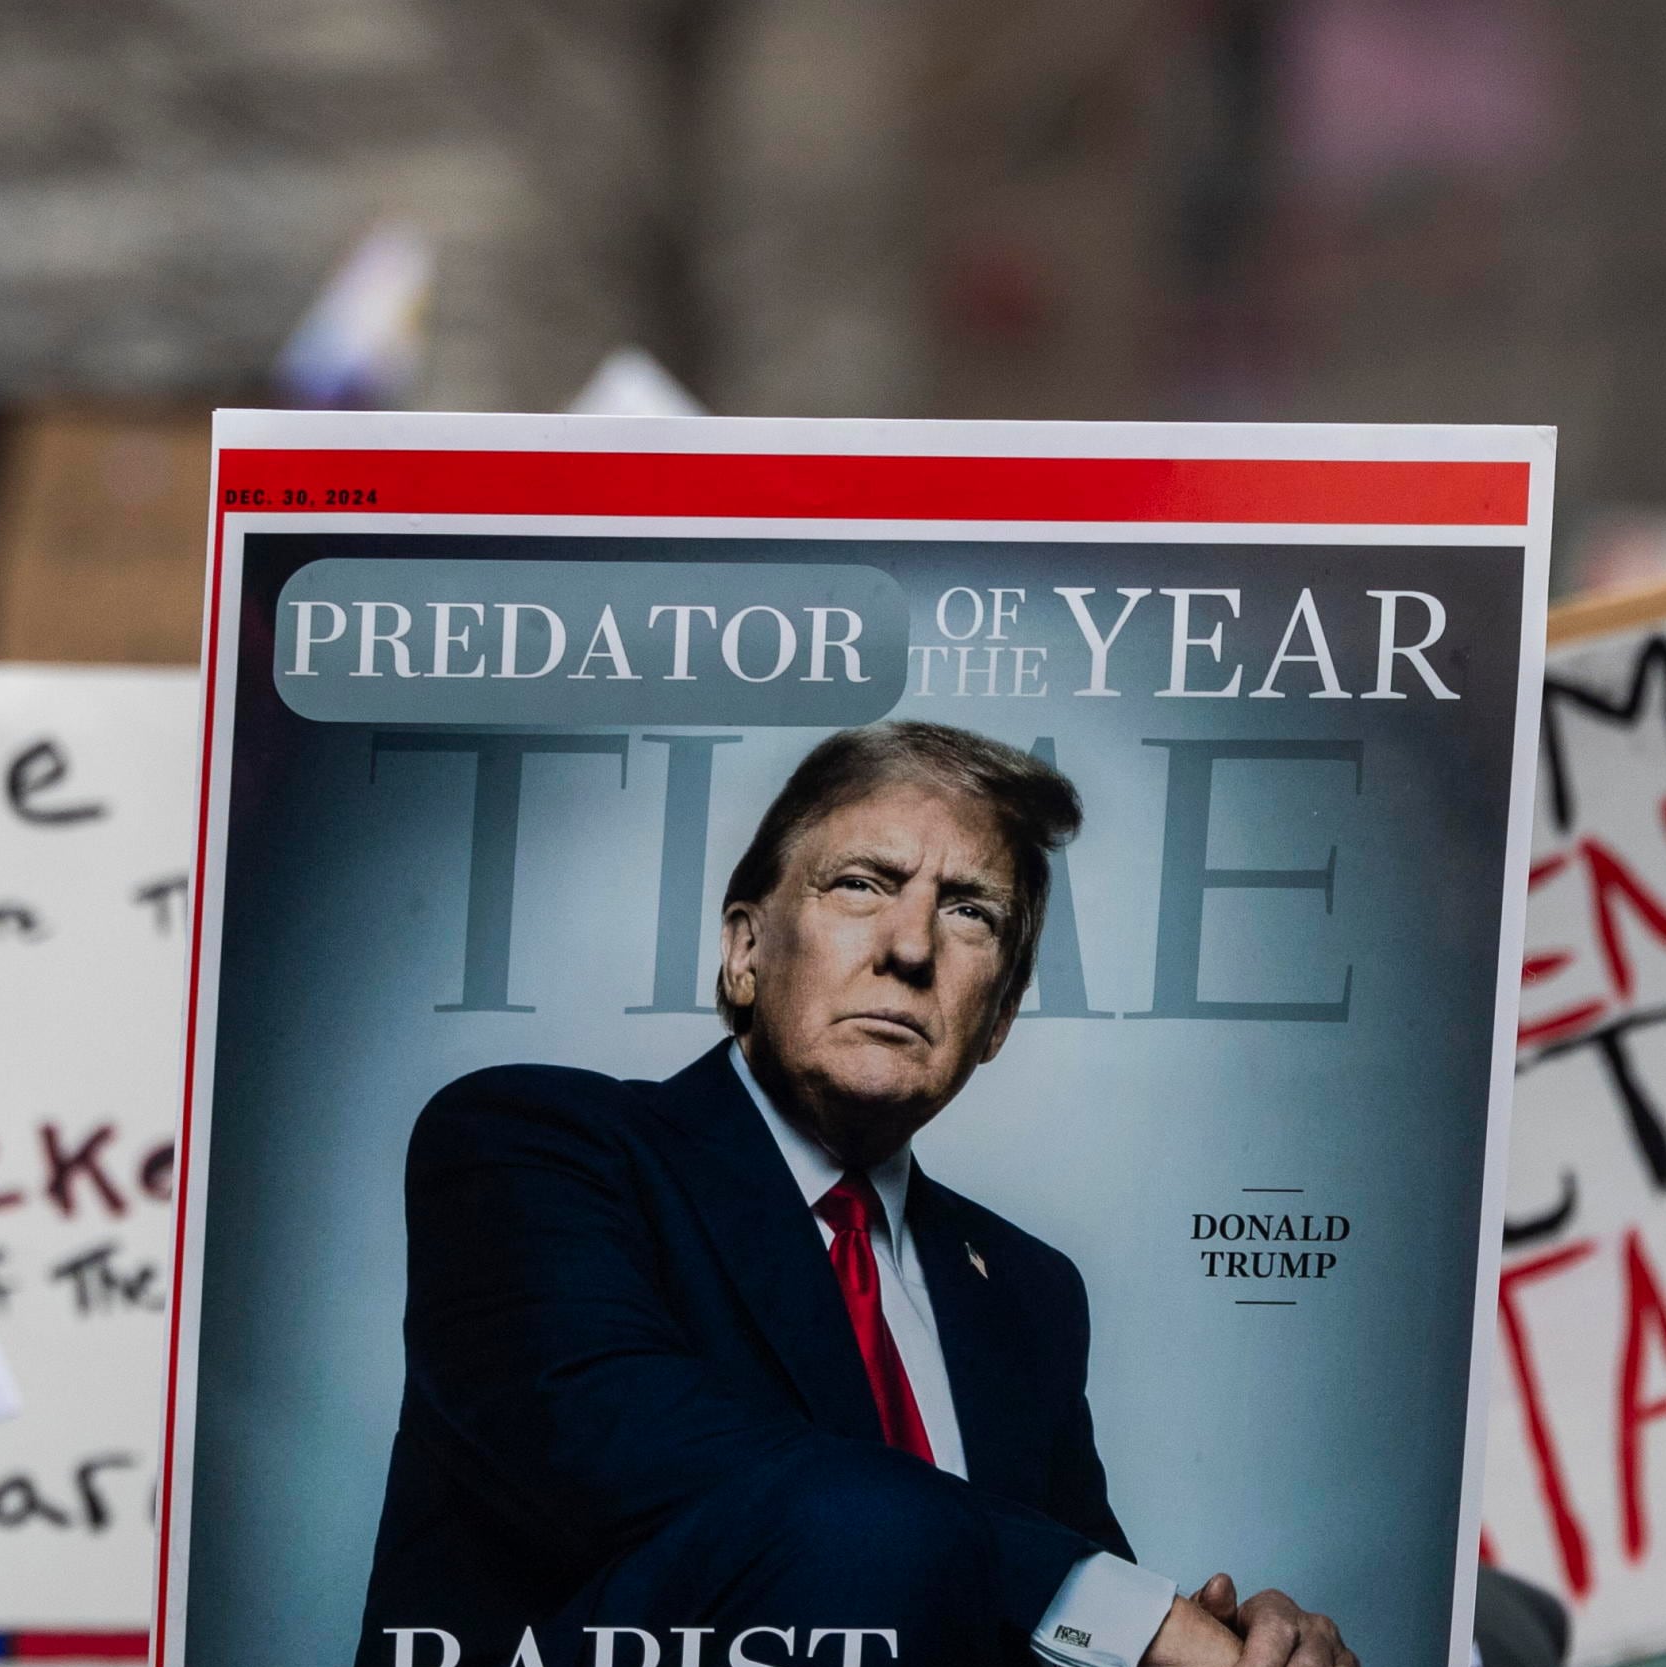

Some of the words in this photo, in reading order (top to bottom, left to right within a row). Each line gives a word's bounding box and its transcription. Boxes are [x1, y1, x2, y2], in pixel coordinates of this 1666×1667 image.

[224, 489, 273, 506] DEC.
[282, 489, 316, 508] 30,
[324, 488, 379, 506] 2024
[284, 600, 871, 684] PREDATOR
[935, 586, 1026, 641] OF
[1053, 586, 1461, 701] YEAR
[909, 646, 1049, 698] THE
[369, 728, 1365, 1024] TIE
[1190, 1212, 1351, 1243] DONALD
[1200, 1250, 1338, 1280] TRUMP
